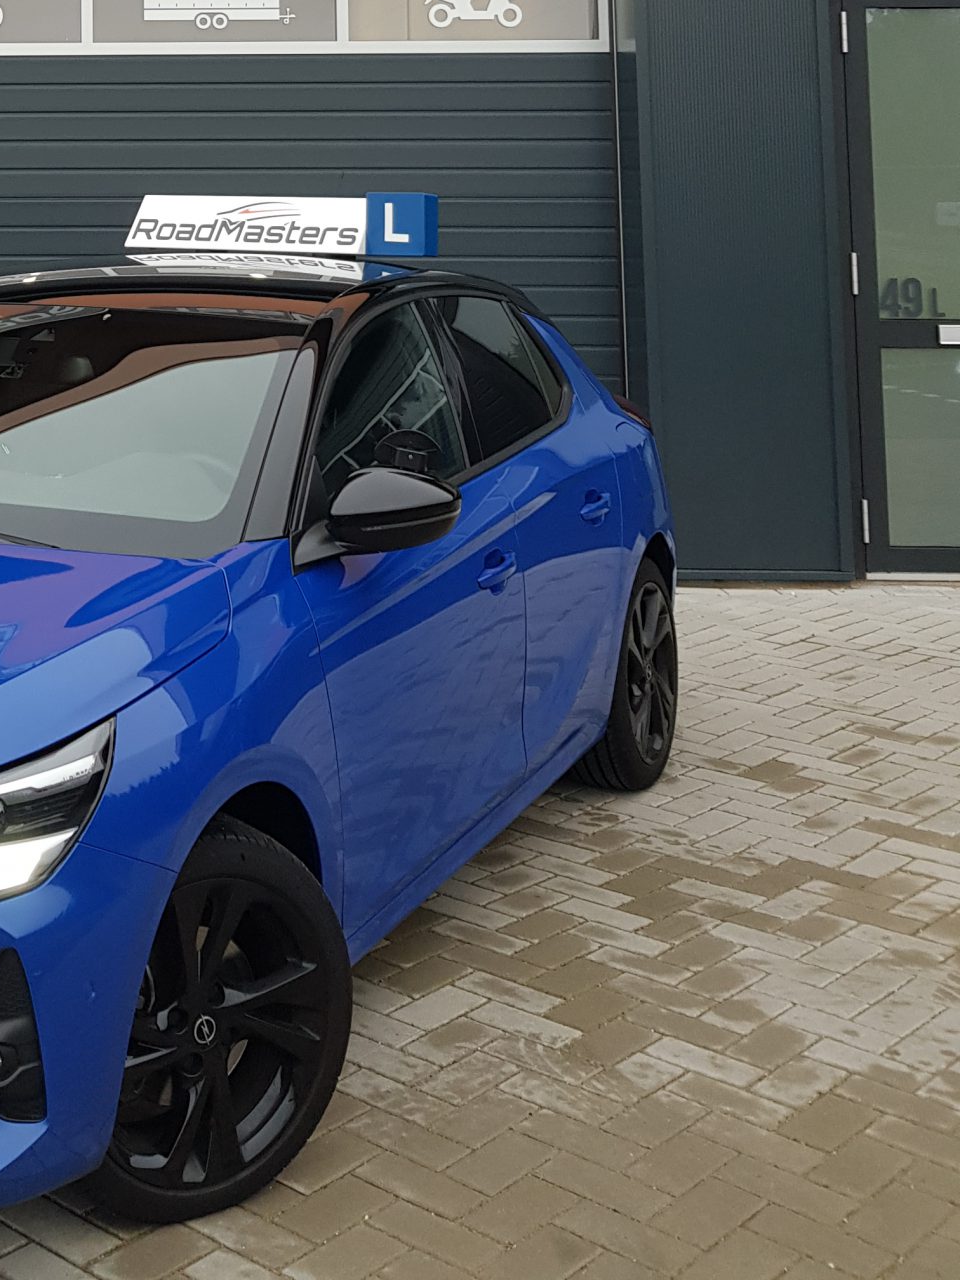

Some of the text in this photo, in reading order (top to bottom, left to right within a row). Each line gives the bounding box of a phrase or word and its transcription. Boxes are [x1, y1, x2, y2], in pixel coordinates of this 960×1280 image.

[132, 218, 358, 246] RoadMasters
[384, 202, 409, 243] L
[879, 277, 923, 317] 49
